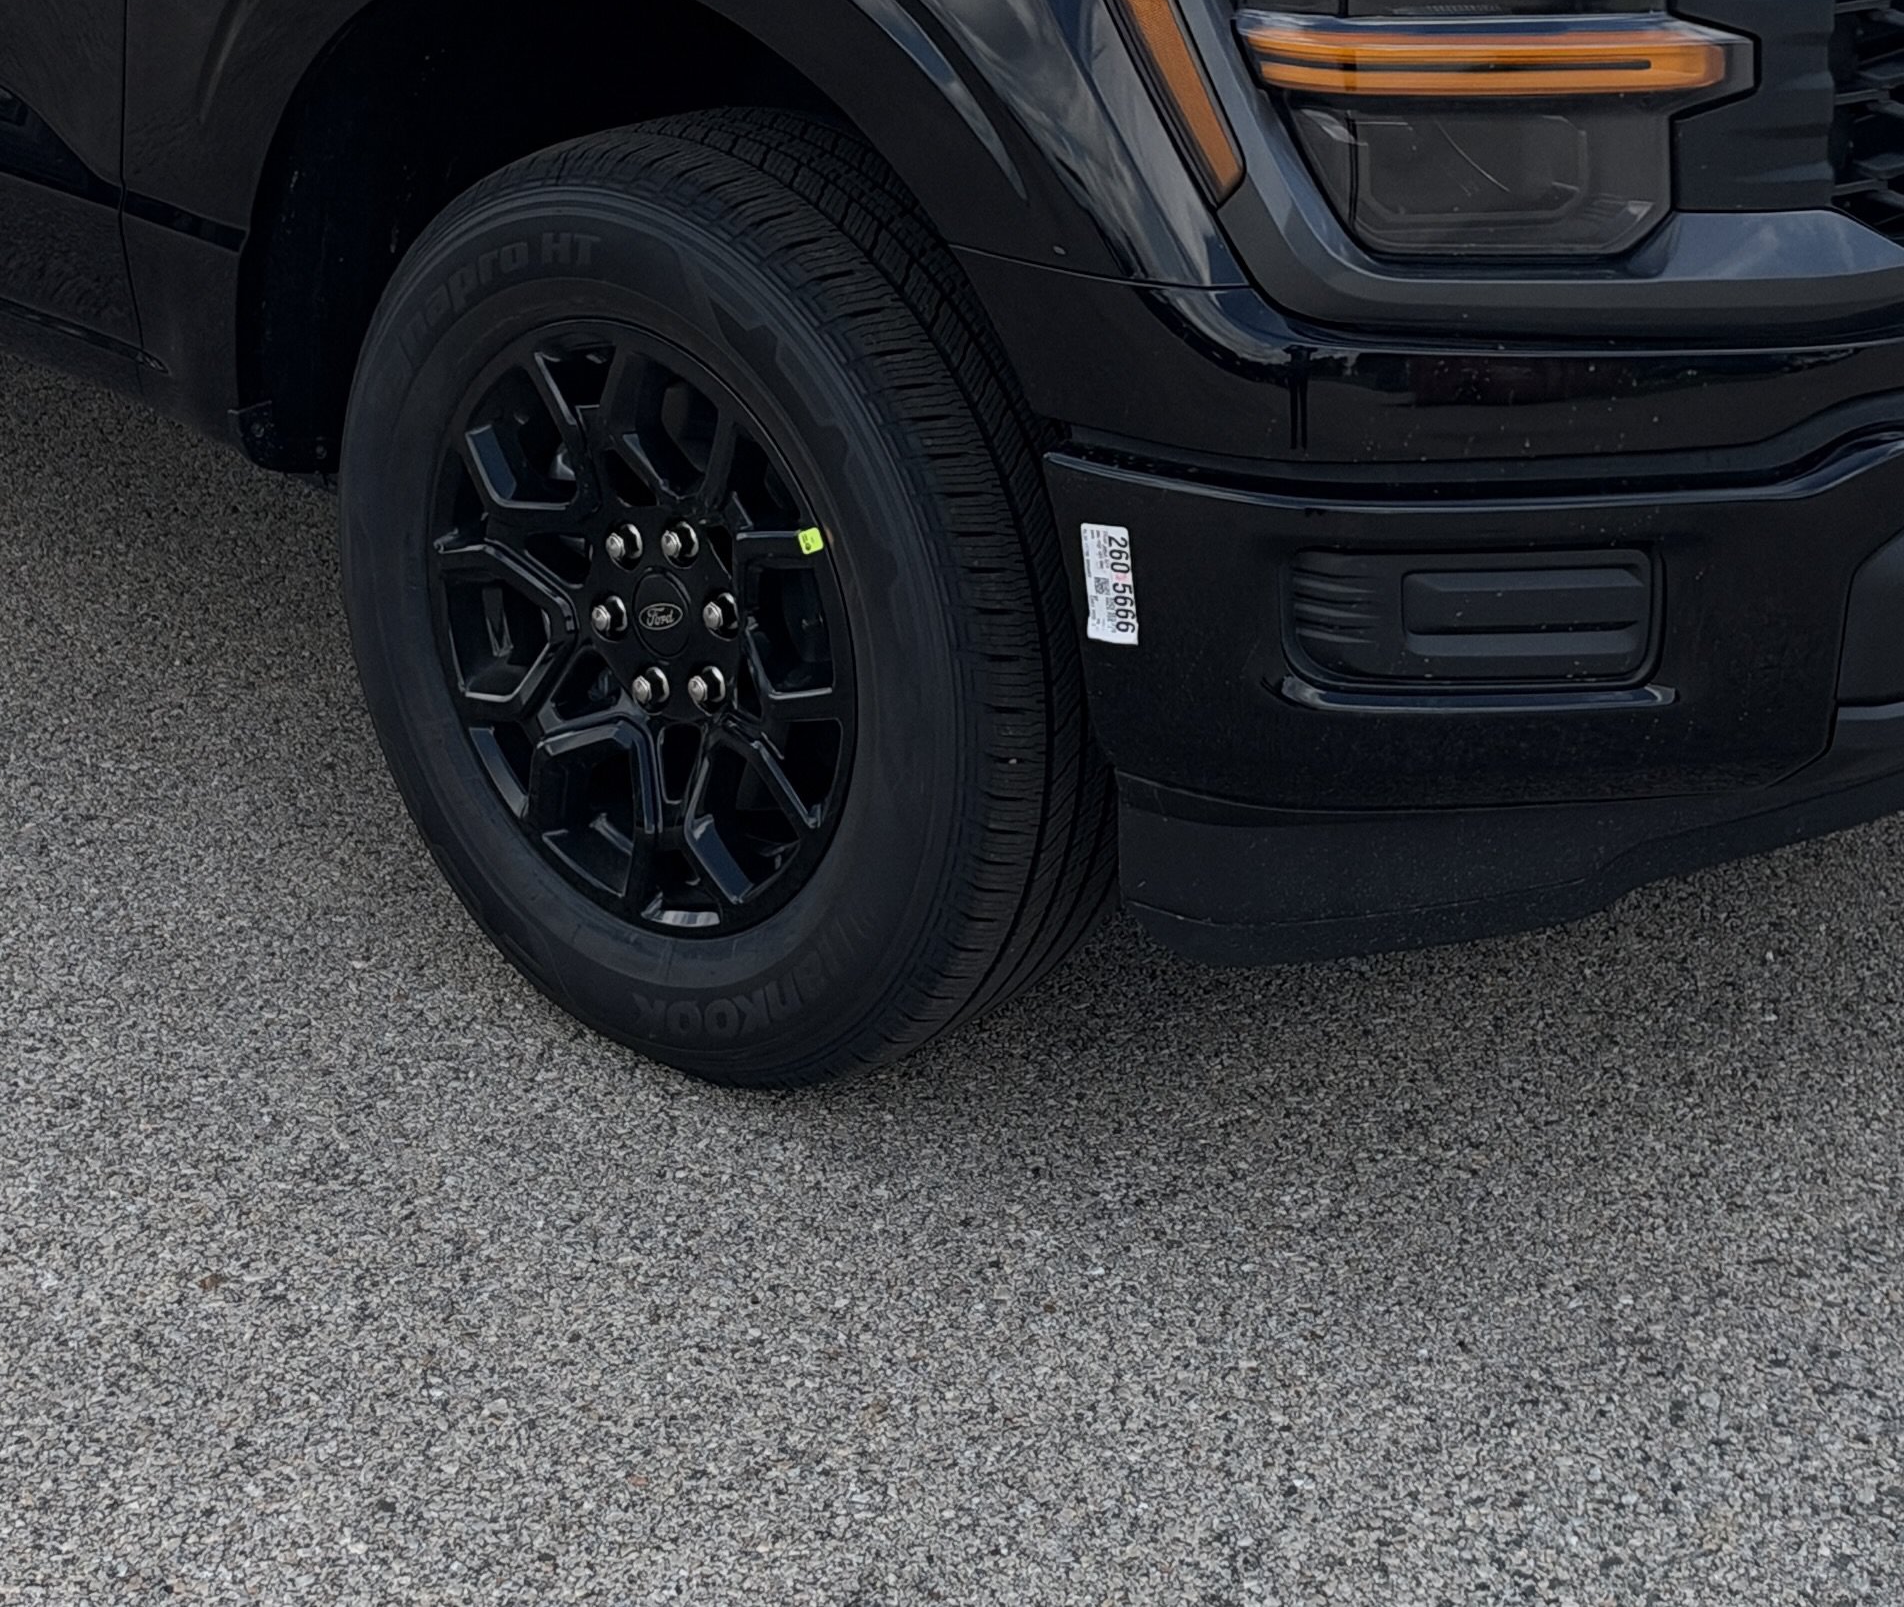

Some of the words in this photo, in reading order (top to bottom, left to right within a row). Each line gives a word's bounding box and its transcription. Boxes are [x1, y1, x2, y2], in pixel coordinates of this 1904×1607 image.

[540, 231, 602, 267] HT
[1107, 535, 1130, 574] 260
[646, 607, 675, 627] Ford
[1112, 582, 1136, 634] 5666
